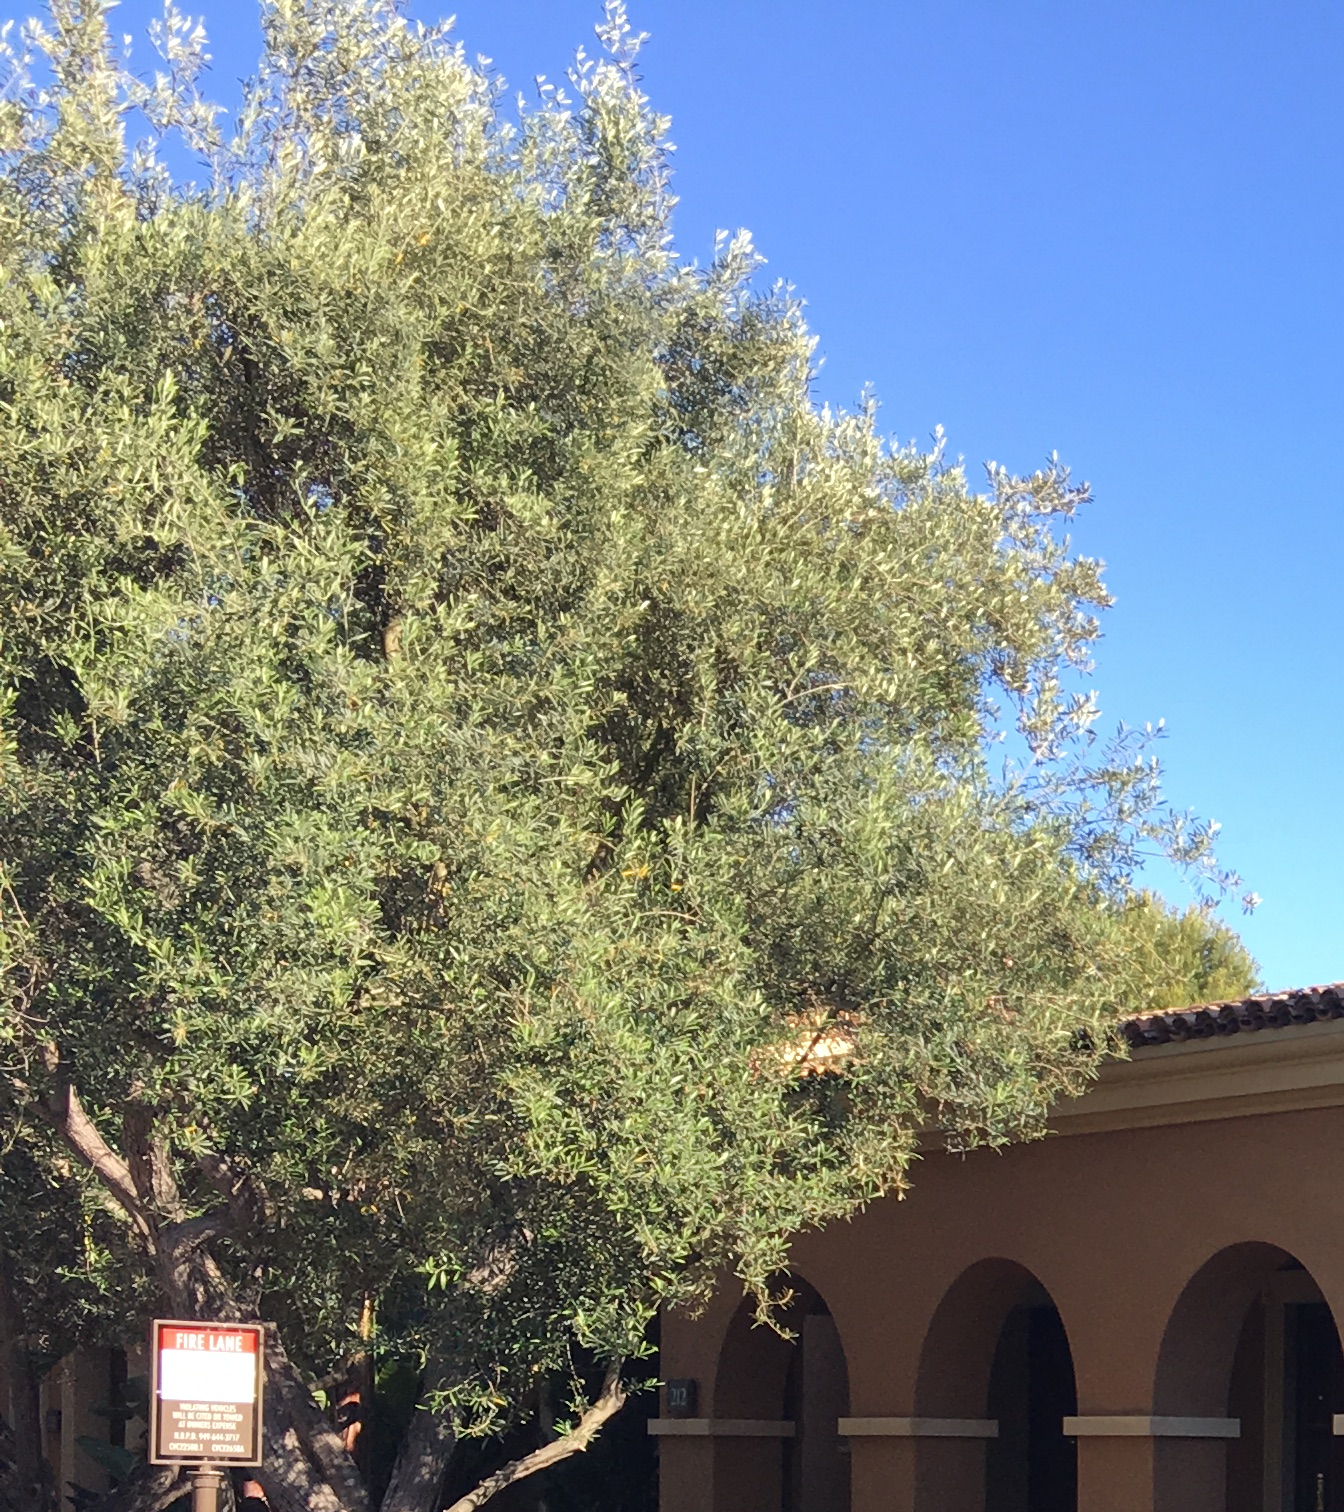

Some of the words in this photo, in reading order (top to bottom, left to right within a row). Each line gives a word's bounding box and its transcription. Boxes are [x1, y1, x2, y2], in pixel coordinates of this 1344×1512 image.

[176, 1332, 205, 1350] FIRE
[209, 1334, 243, 1352] LANE
[671, 1387, 686, 1406] 212
[211, 1404, 236, 1413] VEHICLES
[172, 1411, 186, 1420] WILL
[187, 1412, 195, 1420] BE
[196, 1412, 212, 1420] CITED
[213, 1413, 222, 1421] OR
[223, 1413, 243, 1422] TOWED
[178, 1420, 186, 1428] AT
[212, 1422, 236, 1430] EXPENSE
